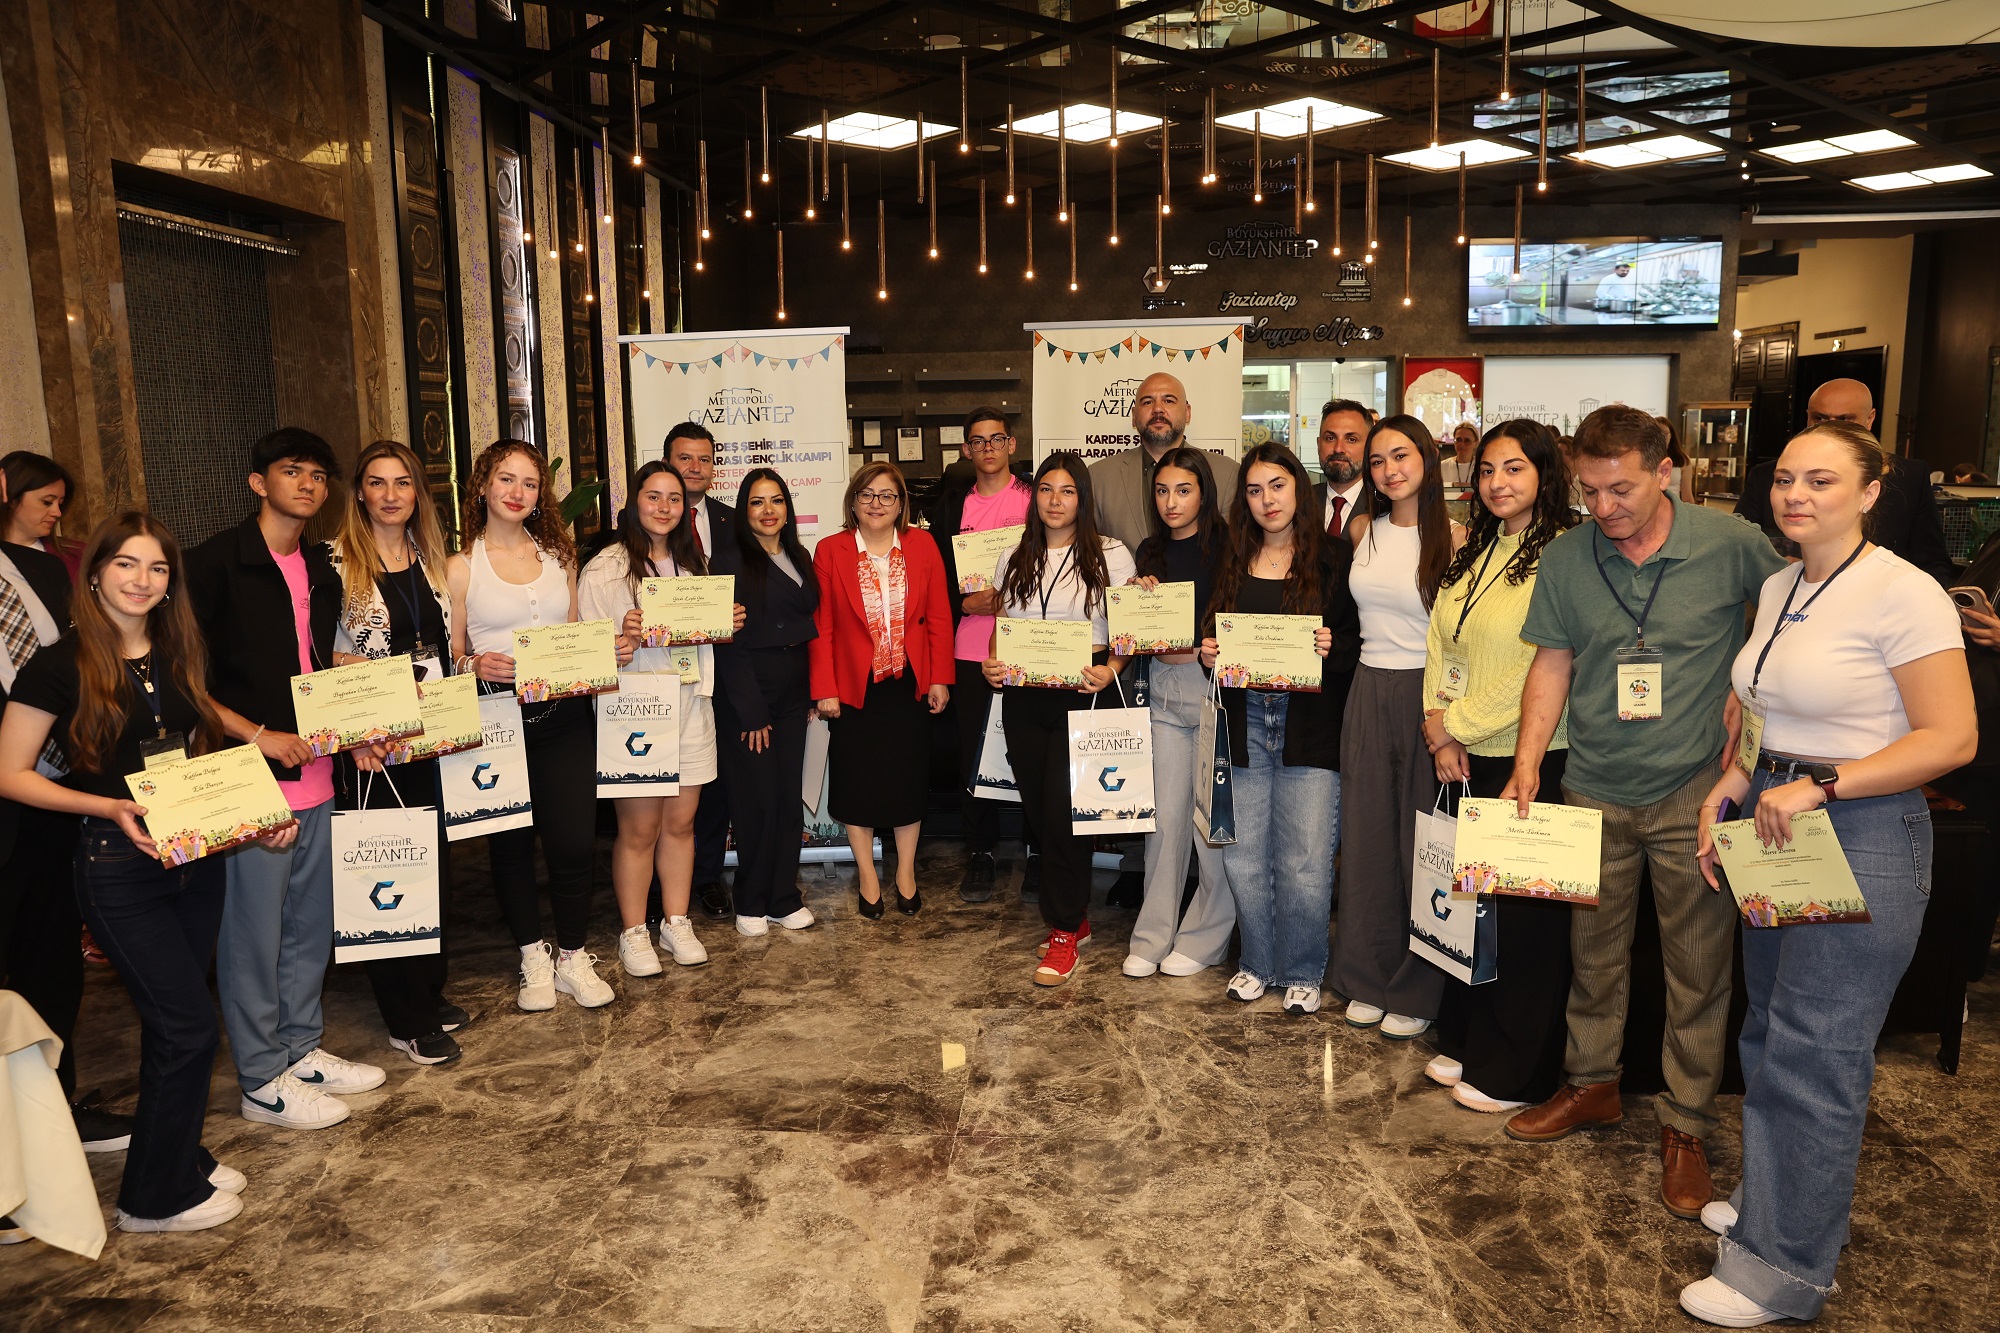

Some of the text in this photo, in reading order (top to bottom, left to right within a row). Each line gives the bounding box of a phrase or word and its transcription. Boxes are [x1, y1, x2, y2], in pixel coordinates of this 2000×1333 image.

[1227, 226, 1298, 240] BÜYÜKŞEHİR
[1207, 239, 1319, 260] GAZİANTEP
[1219, 292, 1299, 311] Gaziantep
[688, 405, 795, 426] GAZİANTEP
[741, 438, 795, 452] ŞEHİRLER
[1085, 434, 1131, 446] KARDEŞ
[743, 450, 793, 466] GENÇLİK
[795, 452, 832, 464] KAMPI
[712, 468, 746, 478] SISTER
[790, 477, 822, 488] CAMP
[618, 695, 660, 705] BÜYÜKŞEHİR
[606, 703, 672, 717] GAZİANTEP
[1088, 729, 1131, 739] BÜYÜKŞEHİR
[1077, 737, 1144, 752] GAZİANTEP
[358, 837, 412, 848] BÜYÜKŞEHİR
[343, 847, 428, 864] GAZİANTEP
[1419, 847, 1454, 874] GAZİAN
